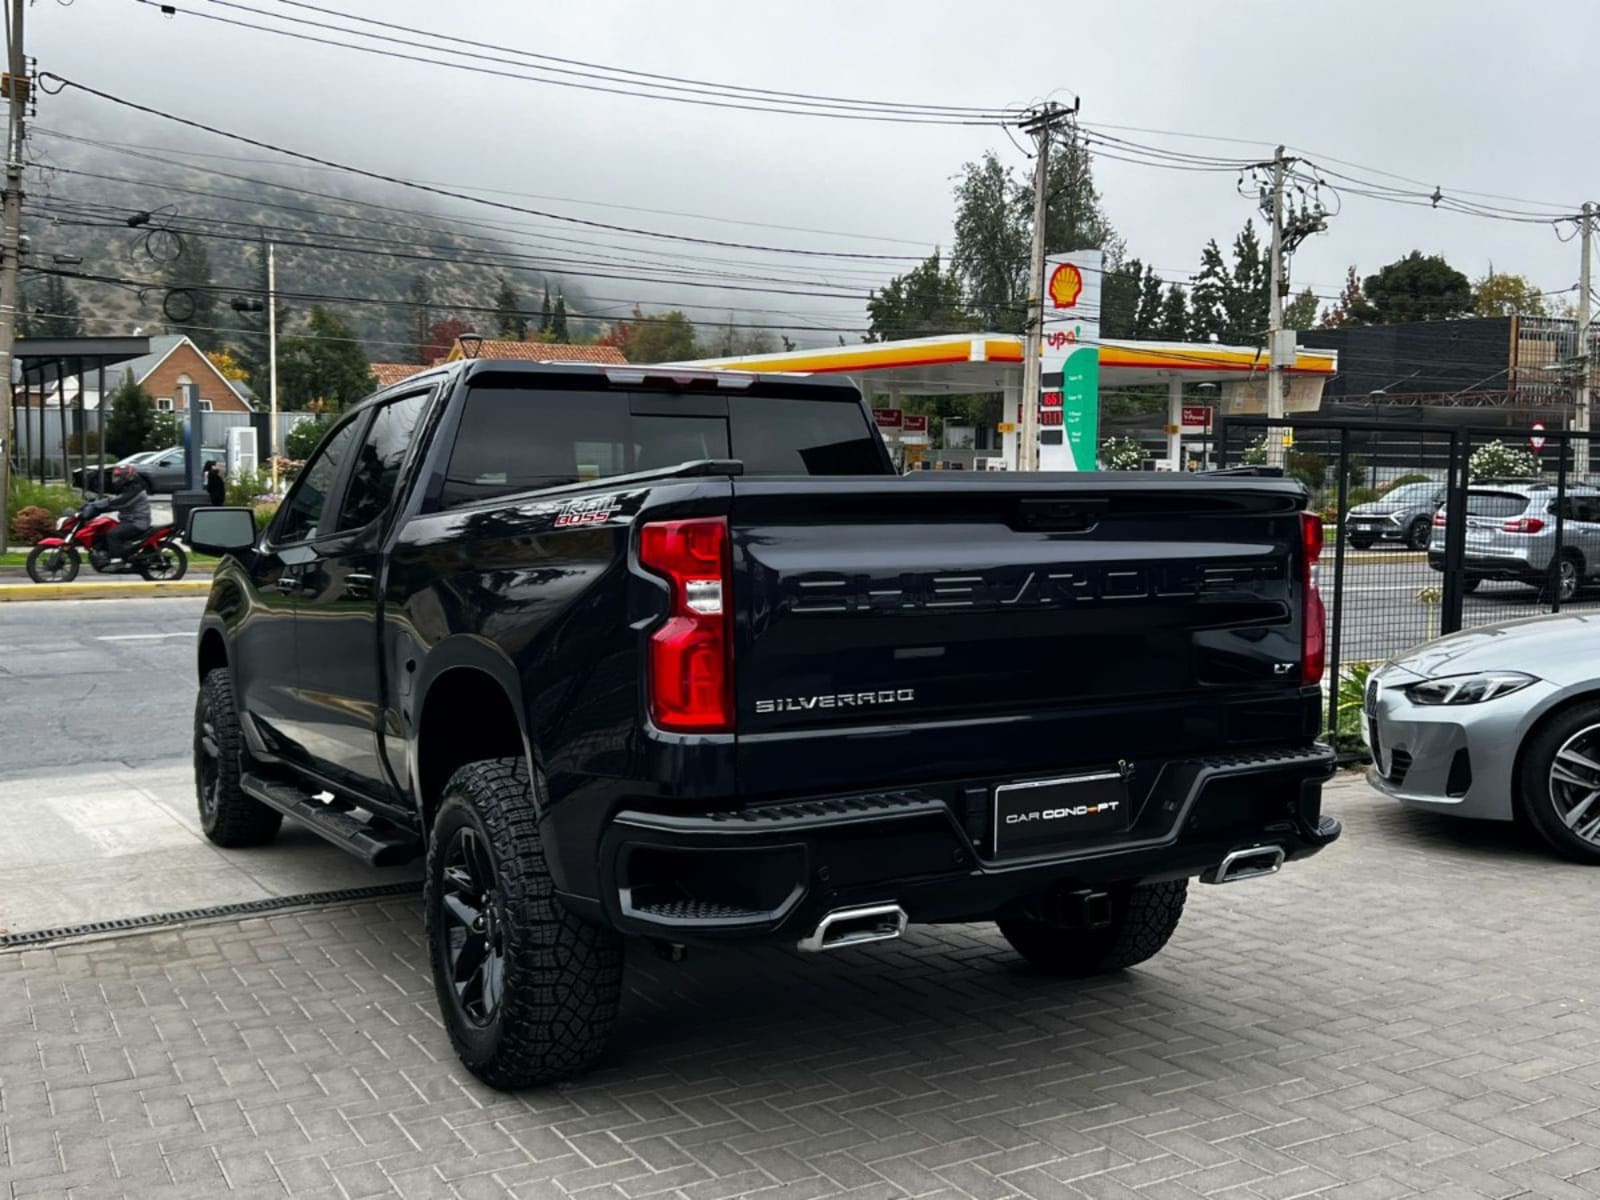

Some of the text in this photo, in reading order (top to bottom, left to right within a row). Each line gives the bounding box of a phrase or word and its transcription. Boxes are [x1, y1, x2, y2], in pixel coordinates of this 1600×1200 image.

[555, 496, 622, 515] TRAIL
[554, 511, 610, 527] BOSS
[1274, 663, 1294, 674] LT
[755, 689, 914, 713] SILVERADO
[1006, 801, 1119, 824] CAR CONCPT
